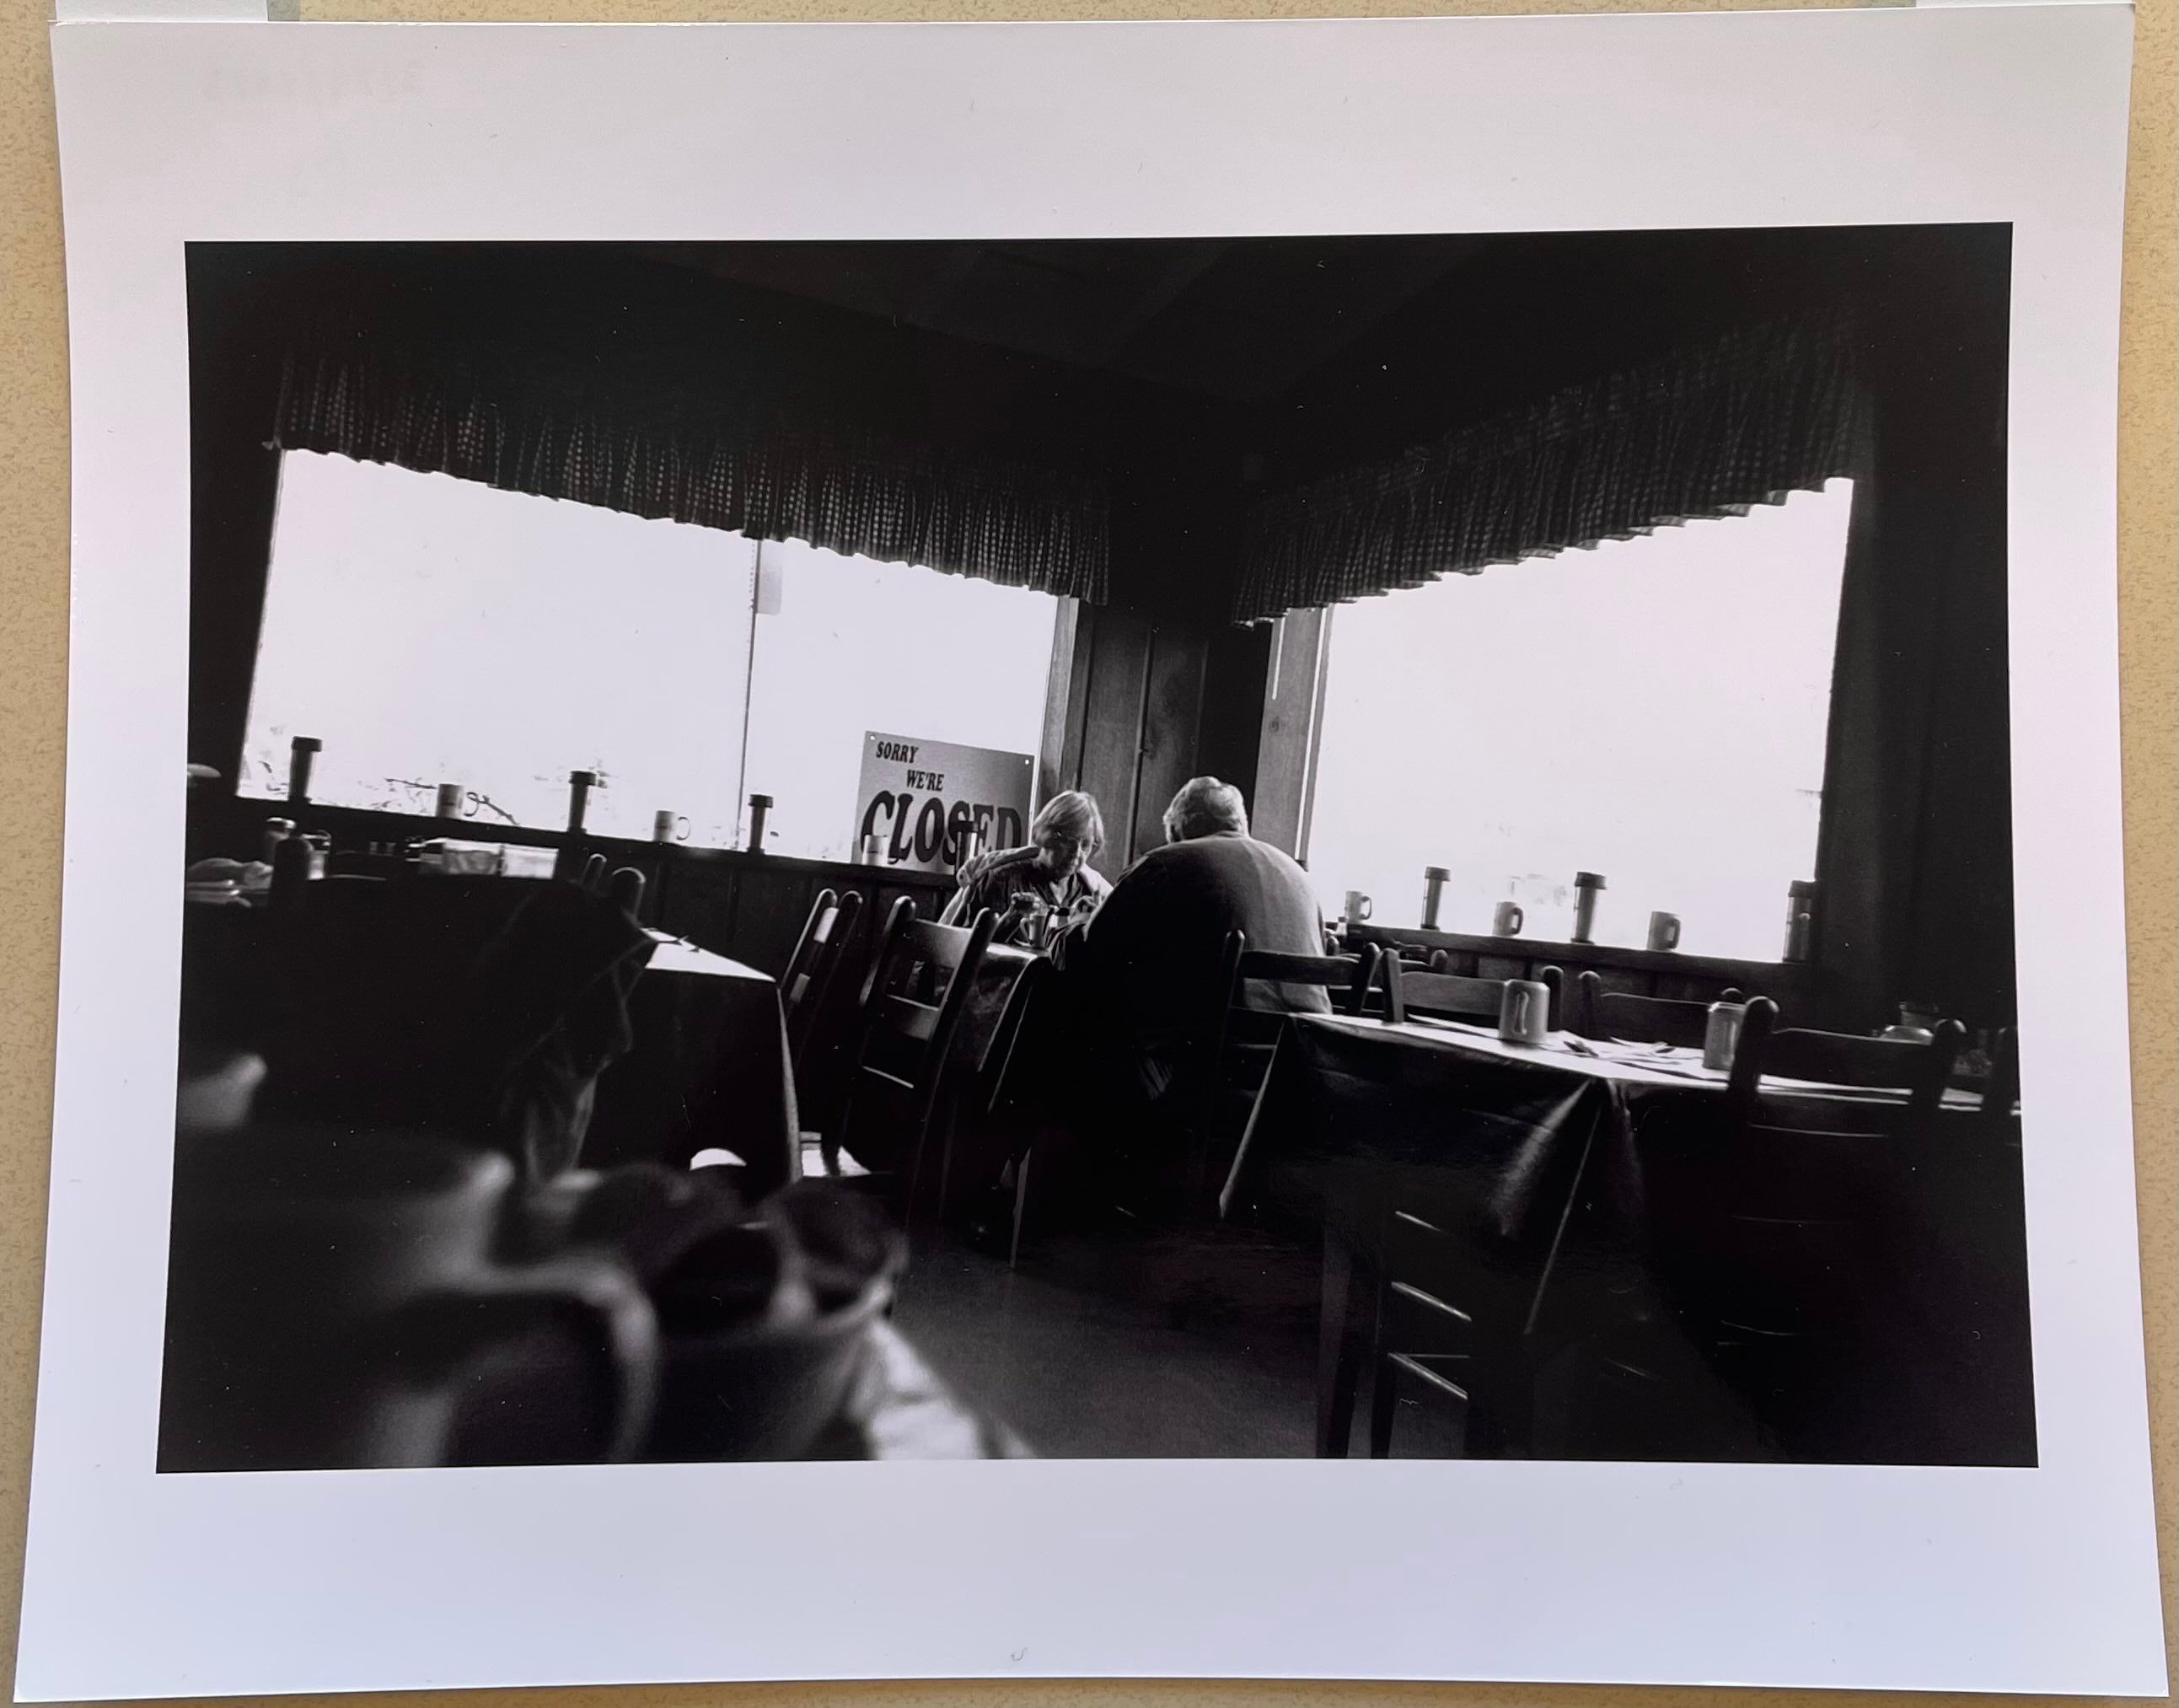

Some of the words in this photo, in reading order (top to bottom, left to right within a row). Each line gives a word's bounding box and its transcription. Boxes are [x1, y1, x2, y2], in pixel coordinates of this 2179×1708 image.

[876, 741, 918, 763] SORRY
[906, 770, 944, 791] WE'RE
[860, 790, 1022, 865] CLOSED
